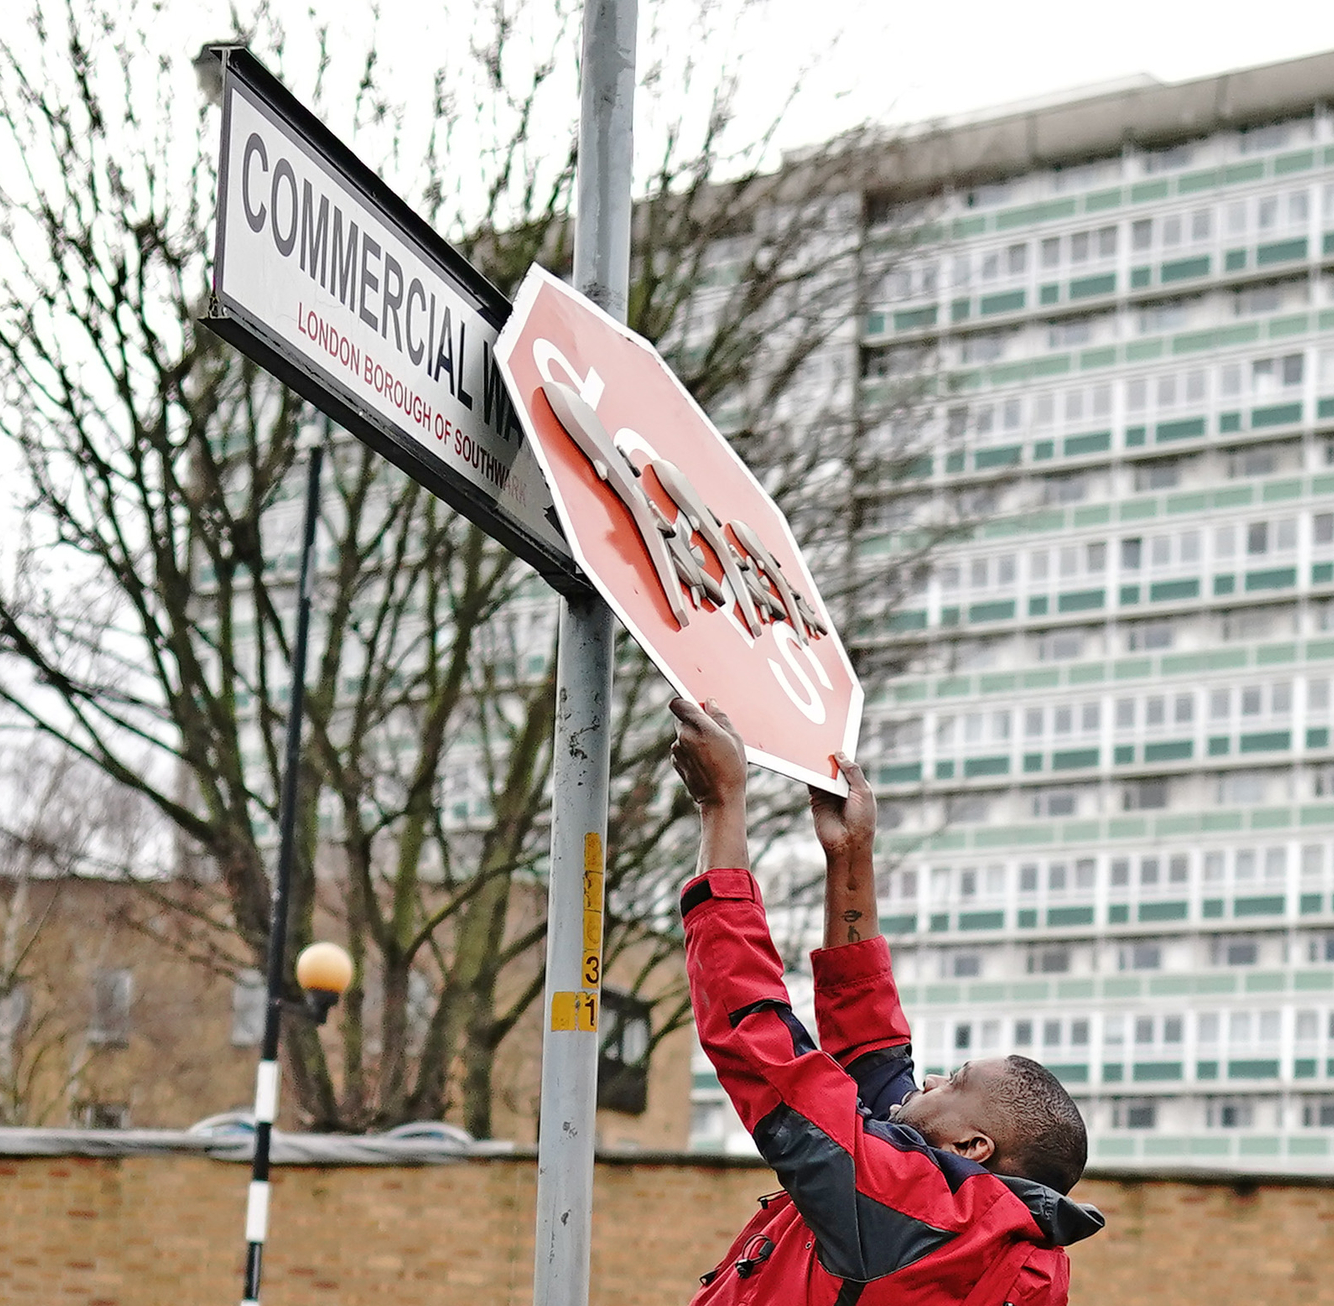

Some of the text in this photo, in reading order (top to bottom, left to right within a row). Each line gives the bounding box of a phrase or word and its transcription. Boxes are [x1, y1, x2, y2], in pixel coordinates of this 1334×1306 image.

[242, 132, 472, 411] COMMERCIAL
[298, 302, 526, 507] LONDON BOROUGH OF SOUTHWARK
[584, 956, 600, 985] 3
